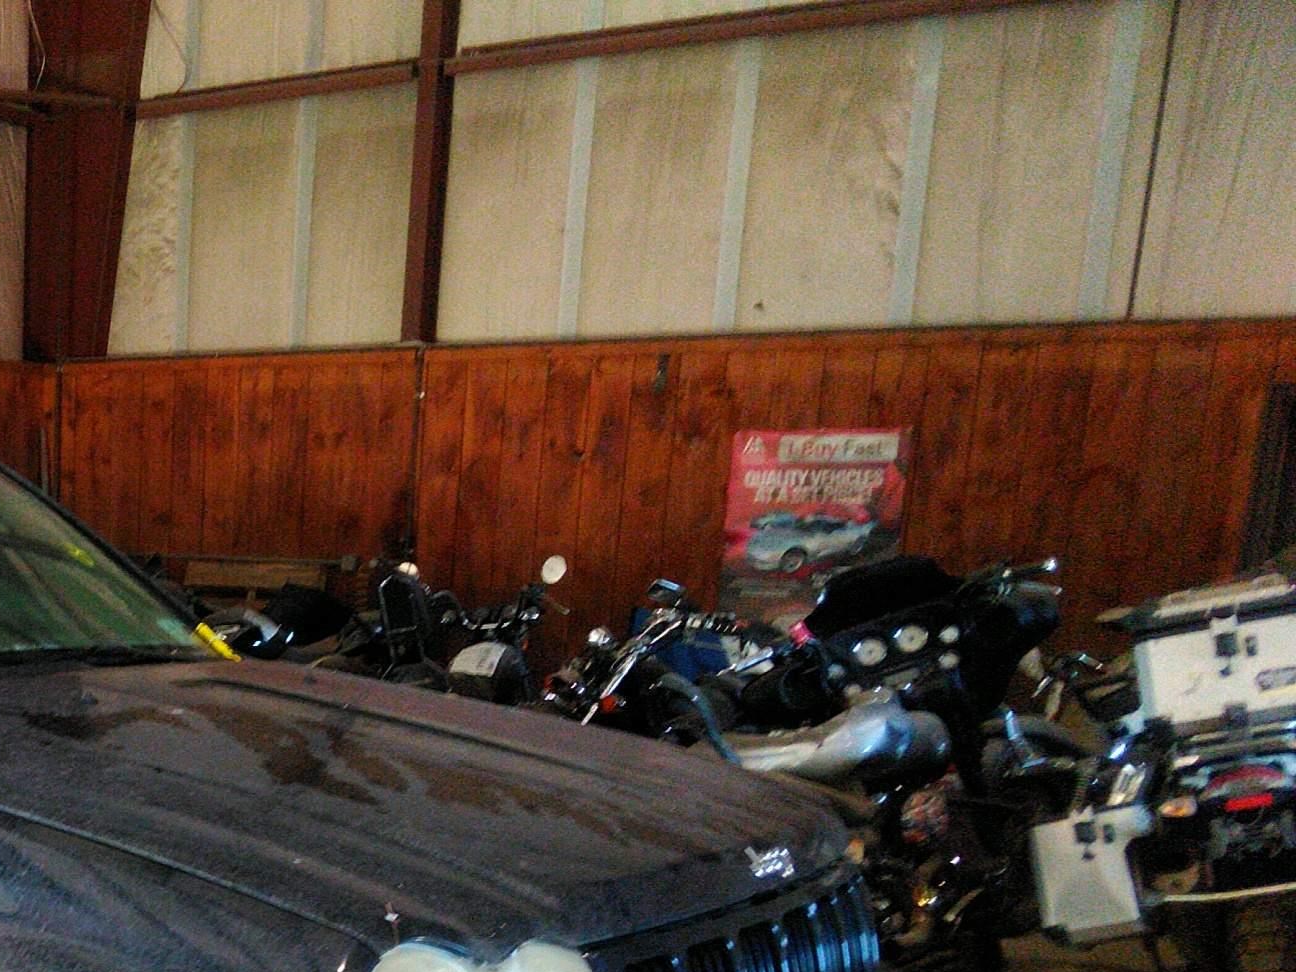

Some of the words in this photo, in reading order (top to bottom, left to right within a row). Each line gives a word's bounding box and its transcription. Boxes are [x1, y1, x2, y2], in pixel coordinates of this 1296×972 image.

[843, 439, 883, 457] Fast
[744, 468, 810, 488] QUALITY
[811, 467, 885, 488] VEHICLES
